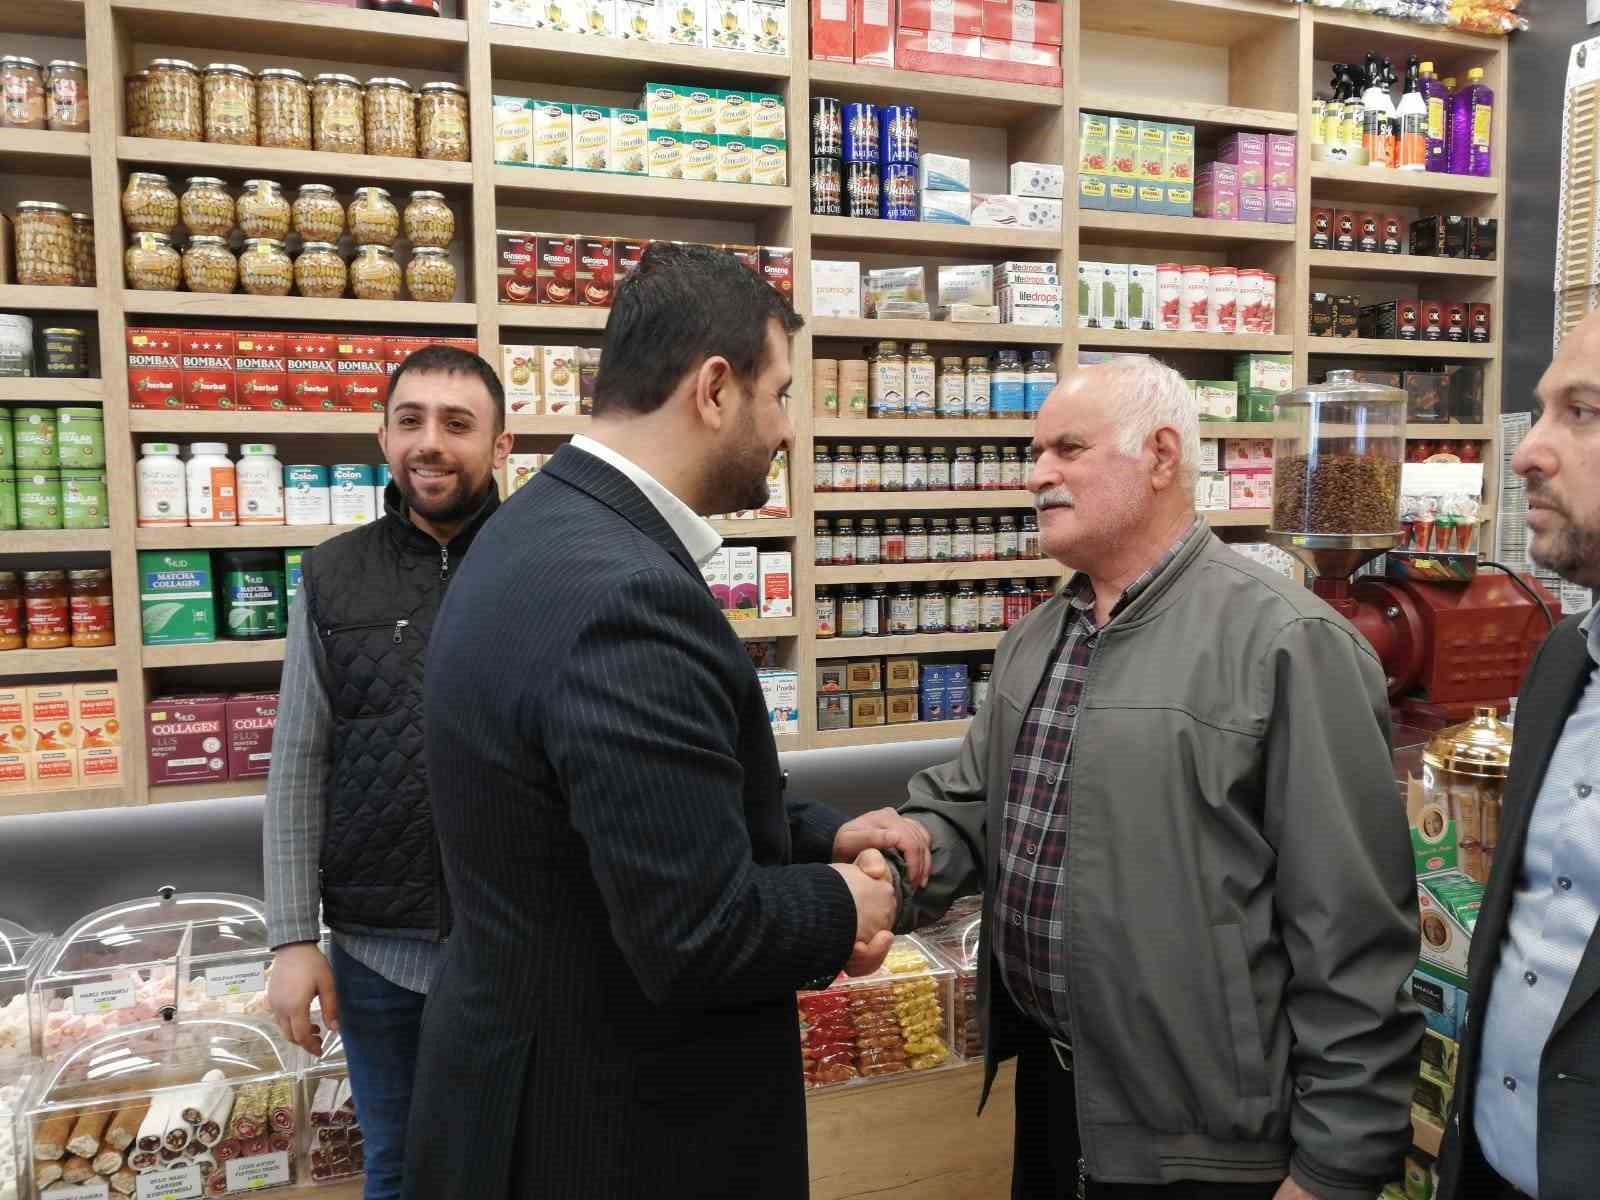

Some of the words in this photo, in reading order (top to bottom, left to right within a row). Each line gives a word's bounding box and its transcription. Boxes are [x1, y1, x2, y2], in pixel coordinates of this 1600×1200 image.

[1316, 219, 1327, 227] OK
[1341, 221, 1352, 229] OK
[1363, 224, 1375, 232] OK
[1387, 225, 1397, 233] OK
[503, 252, 530, 262] Ginseng
[543, 254, 570, 264] Ginseng
[582, 256, 608, 266] Ginseng
[764, 265, 788, 276] Ginseng
[1012, 263, 1042, 272] lifedrops
[1014, 275, 1045, 284] lifedrops
[1019, 291, 1057, 303] lifedrops
[1403, 312, 1415, 320] OK
[1429, 312, 1440, 320] OK
[1450, 313, 1461, 321] OK
[129, 355, 178, 368] BOMBAX
[183, 356, 232, 369] BOMBAX
[236, 358, 285, 371] BOMBAX
[287, 359, 334, 372] BOMBAX
[337, 361, 384, 373] BOMBAX
[147, 381, 173, 389] herbal
[200, 383, 226, 391] herbal
[253, 384, 279, 392] herbal
[303, 385, 328, 393] herbal
[157, 572, 195, 580] MATCHA
[152, 579, 200, 588] COLLAGEN
[237, 591, 272, 599] COLLAGEN
[152, 721, 217, 735] COLLAGEN
[235, 718, 277, 729] COLLA
